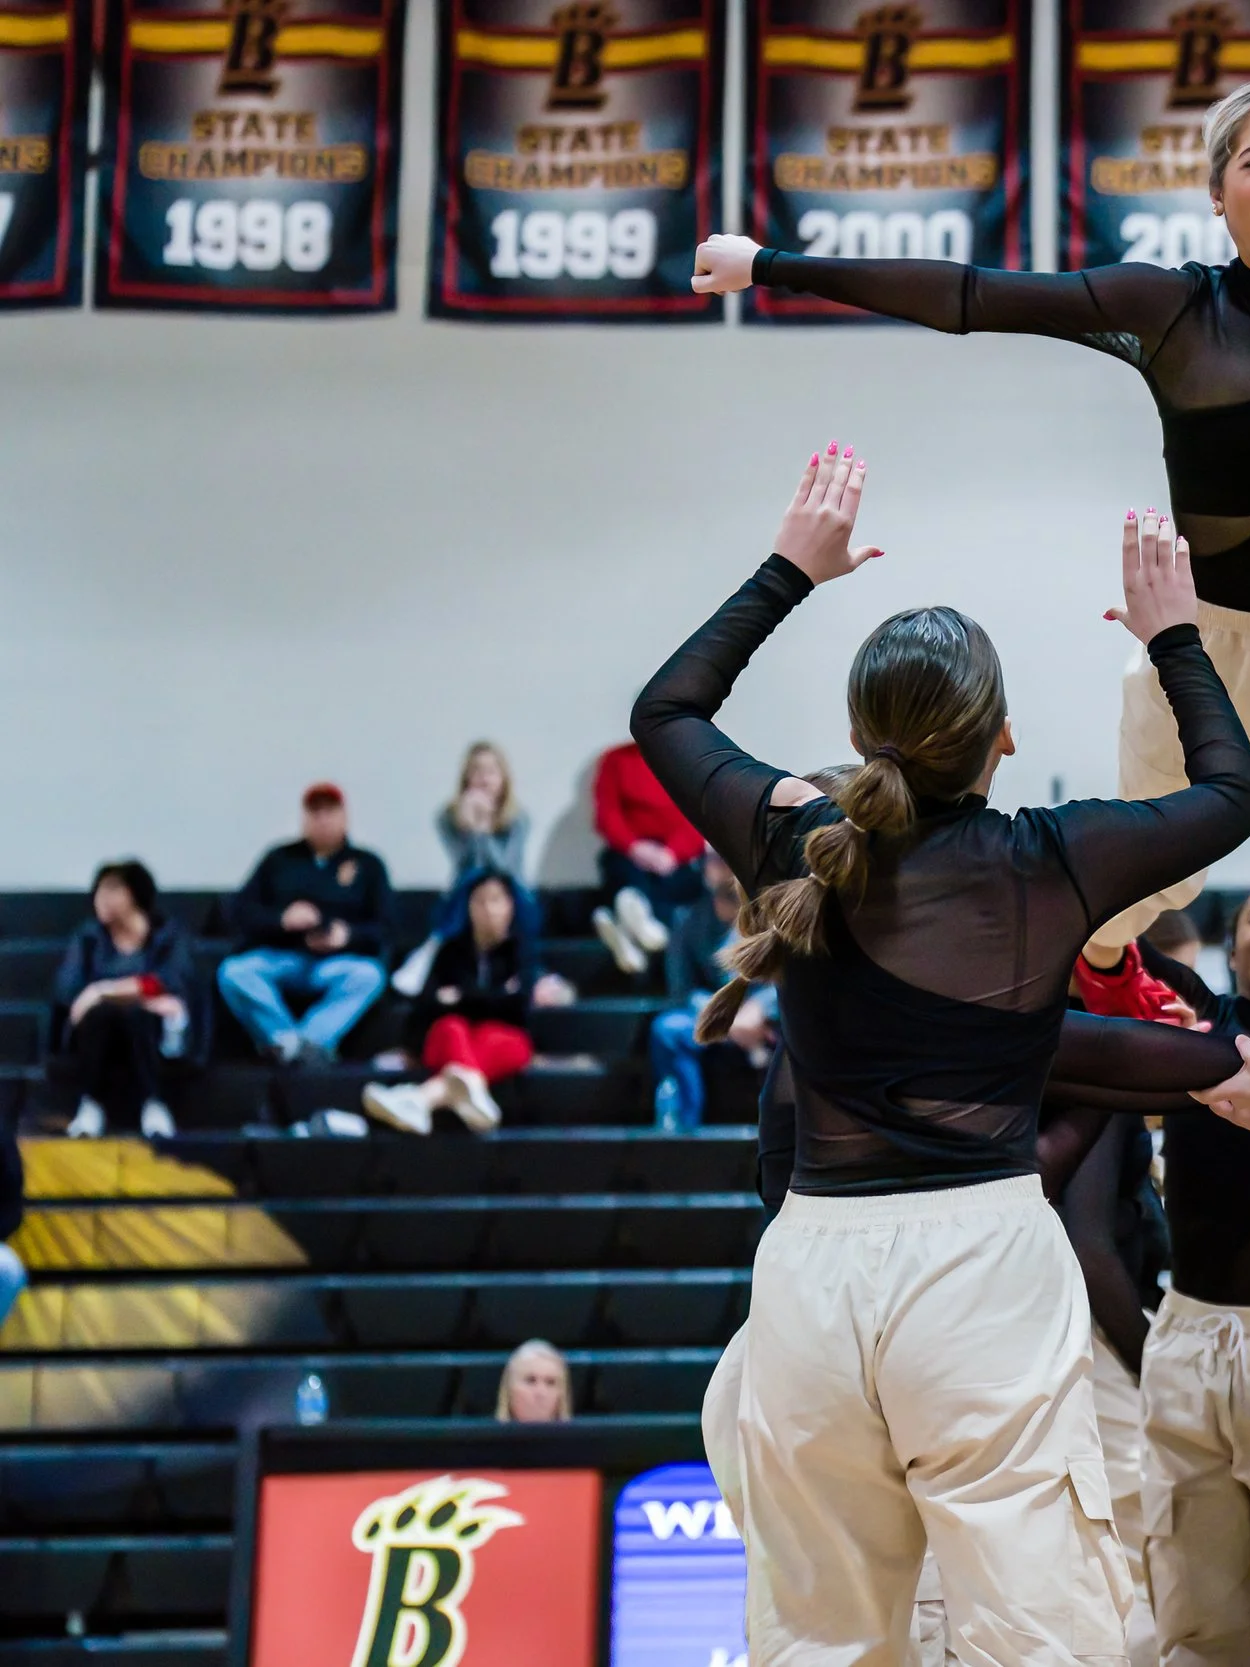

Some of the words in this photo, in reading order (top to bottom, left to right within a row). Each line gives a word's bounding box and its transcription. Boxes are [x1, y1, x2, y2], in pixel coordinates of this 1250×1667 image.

[192, 111, 315, 142] STATE
[516, 120, 643, 154] STATE
[827, 125, 950, 155] STATE
[139, 141, 368, 182] CHAMPIONS
[464, 149, 690, 192] CHAMPIONS
[774, 152, 998, 192] CHAMPIONS
[163, 198, 333, 272] 1998
[490, 208, 658, 280] 1999
[797, 208, 974, 265] 2000
